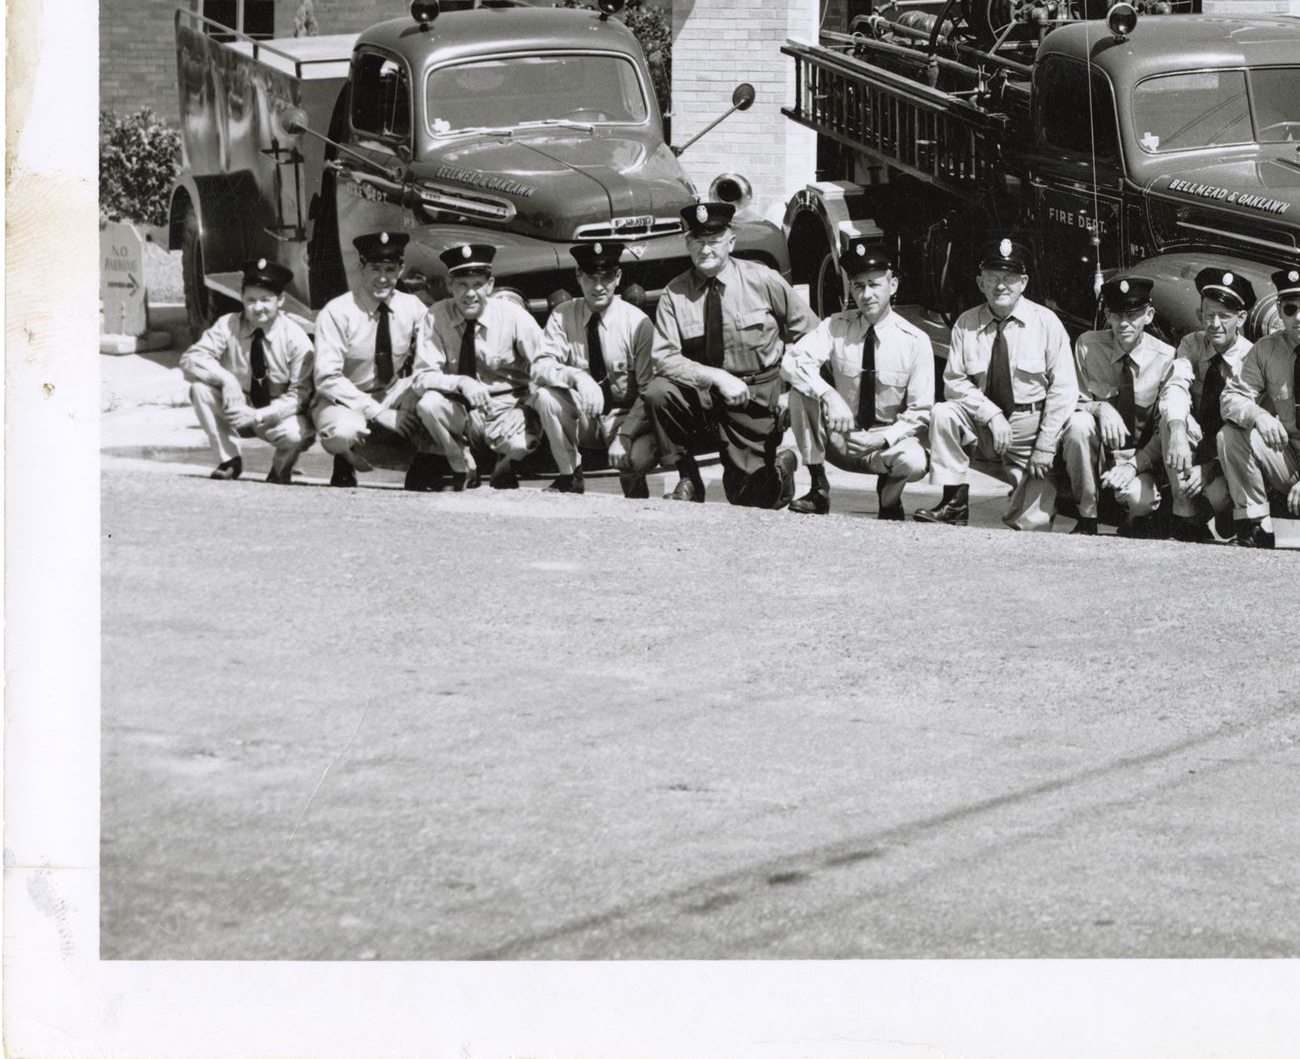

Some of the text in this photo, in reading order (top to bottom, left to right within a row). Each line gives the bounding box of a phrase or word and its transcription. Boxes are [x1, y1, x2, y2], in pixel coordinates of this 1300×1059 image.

[1168, 179, 1291, 215] BELLMEAD & OAKLAWN
[1049, 207, 1107, 234] FIRE DEPT.
[112, 245, 128, 257] NO
